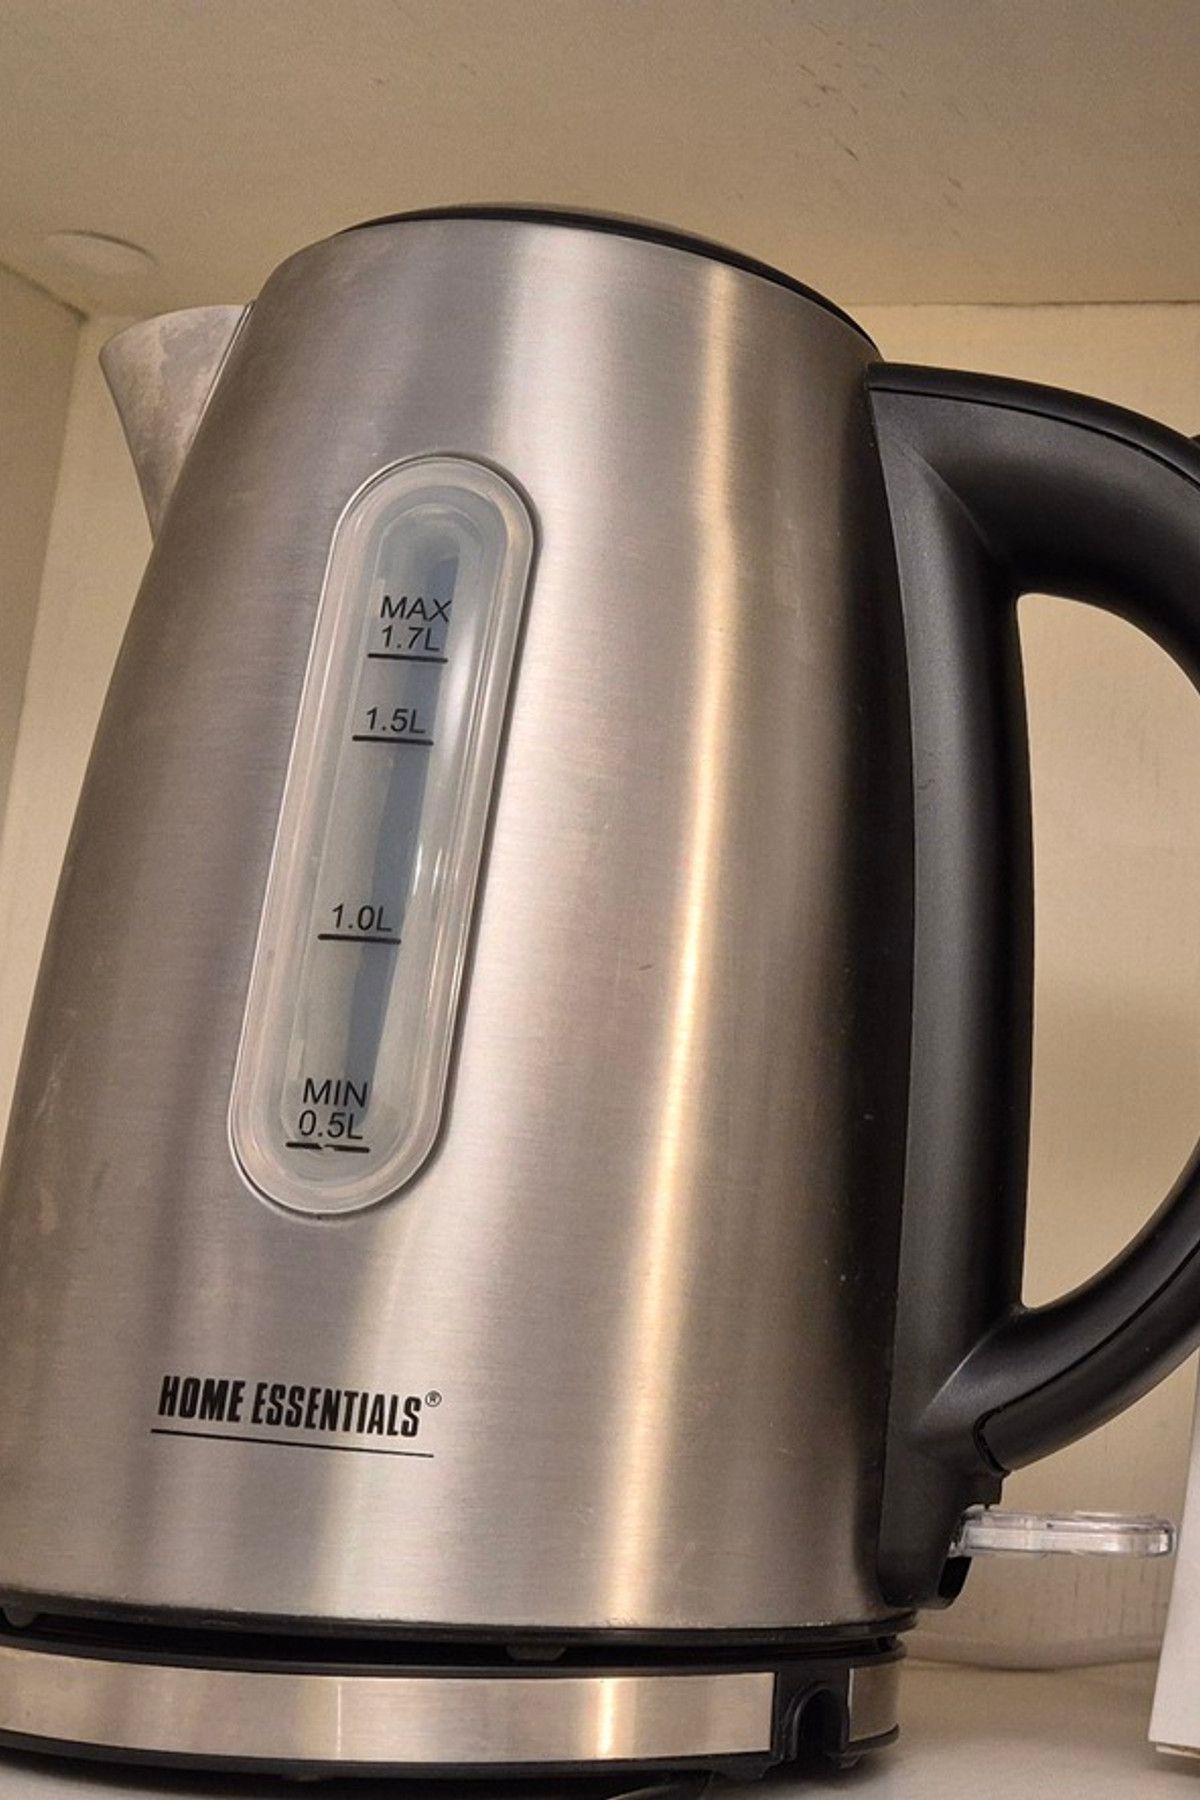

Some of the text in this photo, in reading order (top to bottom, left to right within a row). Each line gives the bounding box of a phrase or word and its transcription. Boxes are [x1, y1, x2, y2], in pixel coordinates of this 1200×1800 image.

[380, 595, 452, 623] MAX
[381, 625, 440, 651] 1.7L
[366, 706, 426, 734] 1.5L
[331, 903, 393, 933] 1.0L
[302, 1077, 368, 1108] MIN
[299, 1110, 364, 1140] 0.5L
[158, 1375, 245, 1423] HOME
